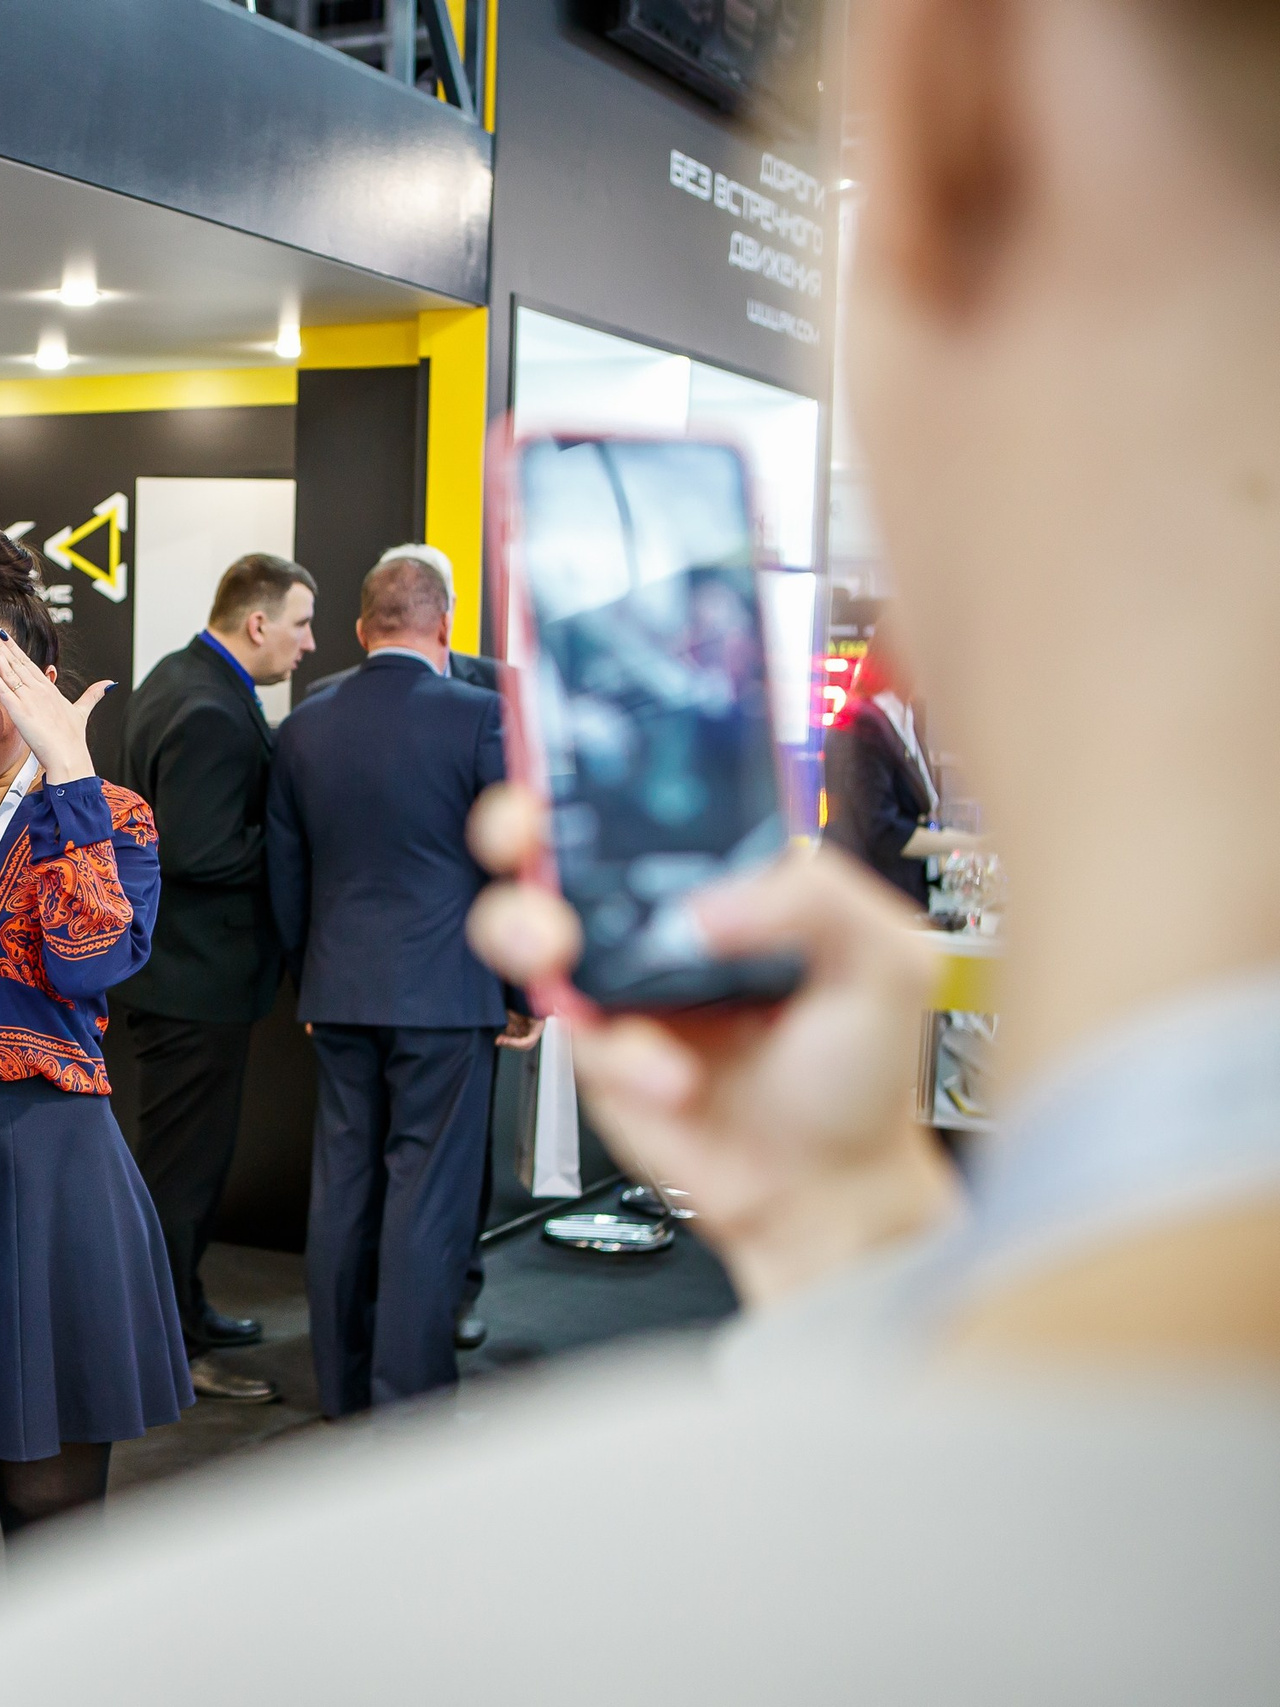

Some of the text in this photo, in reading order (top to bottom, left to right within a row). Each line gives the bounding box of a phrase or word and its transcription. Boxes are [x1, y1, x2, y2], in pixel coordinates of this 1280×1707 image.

[670, 149, 823, 257] БЕЗ ВСТРЕЧНОГО
[761, 153, 825, 212] ДОРОГИ
[728, 231, 821, 298] ДВИЖЕНИЯ
